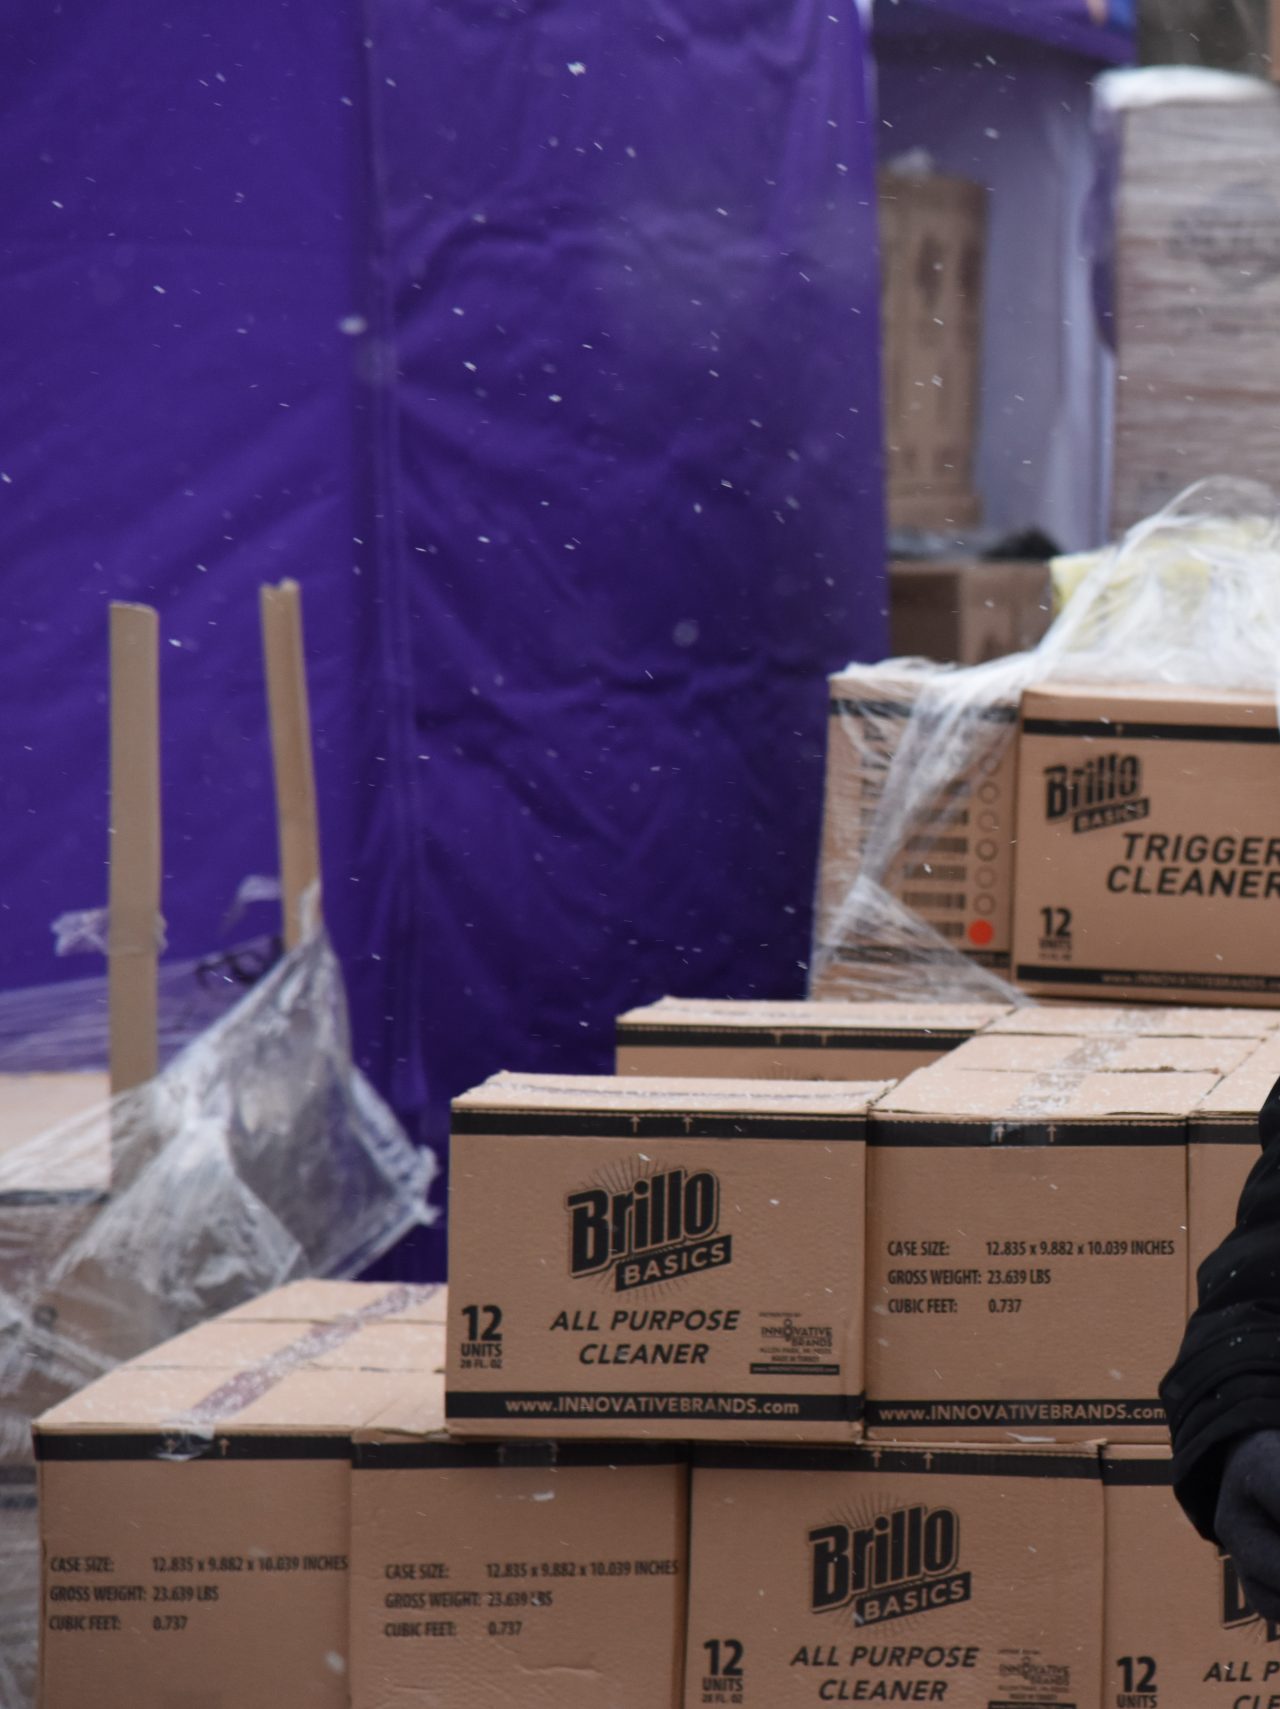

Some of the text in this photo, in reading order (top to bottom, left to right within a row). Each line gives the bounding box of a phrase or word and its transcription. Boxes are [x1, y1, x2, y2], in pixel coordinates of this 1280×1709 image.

[1043, 753, 1142, 822] Brillo
[1040, 906, 1072, 938] 12
[566, 1166, 719, 1278] Brillo
[887, 1240, 1175, 1256] CASE SIZE: 12.835 x 9.882 x 10.039 INCHES
[623, 1242, 725, 1286] BASICS
[887, 1269, 1051, 1285] GROSS WEIGHT: 23.639 LBS
[888, 1299, 1022, 1313] CUBIC FEET: 0.737
[461, 1304, 503, 1342] 12
[550, 1310, 740, 1331] ALL PURPOSE
[461, 1342, 503, 1357] UNITS
[578, 1343, 709, 1365] CLEANER
[504, 1396, 800, 1415] www.INNOVATIVEBRANDS.com
[50, 1557, 80, 1572] CASE
[83, 1557, 114, 1572] SIZE:
[153, 1557, 194, 1572] 12.835
[208, 1557, 243, 1572] 9.882
[259, 1556, 299, 1571] 10.039
[302, 1556, 348, 1571] INCHES
[385, 1563, 417, 1579] CASE
[419, 1563, 449, 1578] SIZE:
[486, 1562, 527, 1578] 12.835
[541, 1562, 575, 1577] 9.882
[590, 1561, 631, 1576] 10.039
[634, 1560, 679, 1576] INCHES
[808, 1506, 960, 1614] Brillo
[50, 1586, 219, 1601] GROSS WEIGHT: 23.639 LBS
[385, 1592, 425, 1608] GROSS
[429, 1592, 481, 1608] WEIGHT:
[863, 1579, 966, 1622] BASICS
[49, 1615, 188, 1631] CUBIC FEET: 0.737
[384, 1621, 522, 1637] CUBIC FEET: 0.737
[703, 1638, 744, 1676] 12
[790, 1646, 980, 1668] ALL PURPOSE
[1116, 1656, 1157, 1693] 12
[1203, 1661, 1252, 1682] ALL
[702, 1677, 744, 1692] UNITS
[819, 1680, 948, 1701] CLEANER
[1116, 1694, 1157, 1709] UNITS
